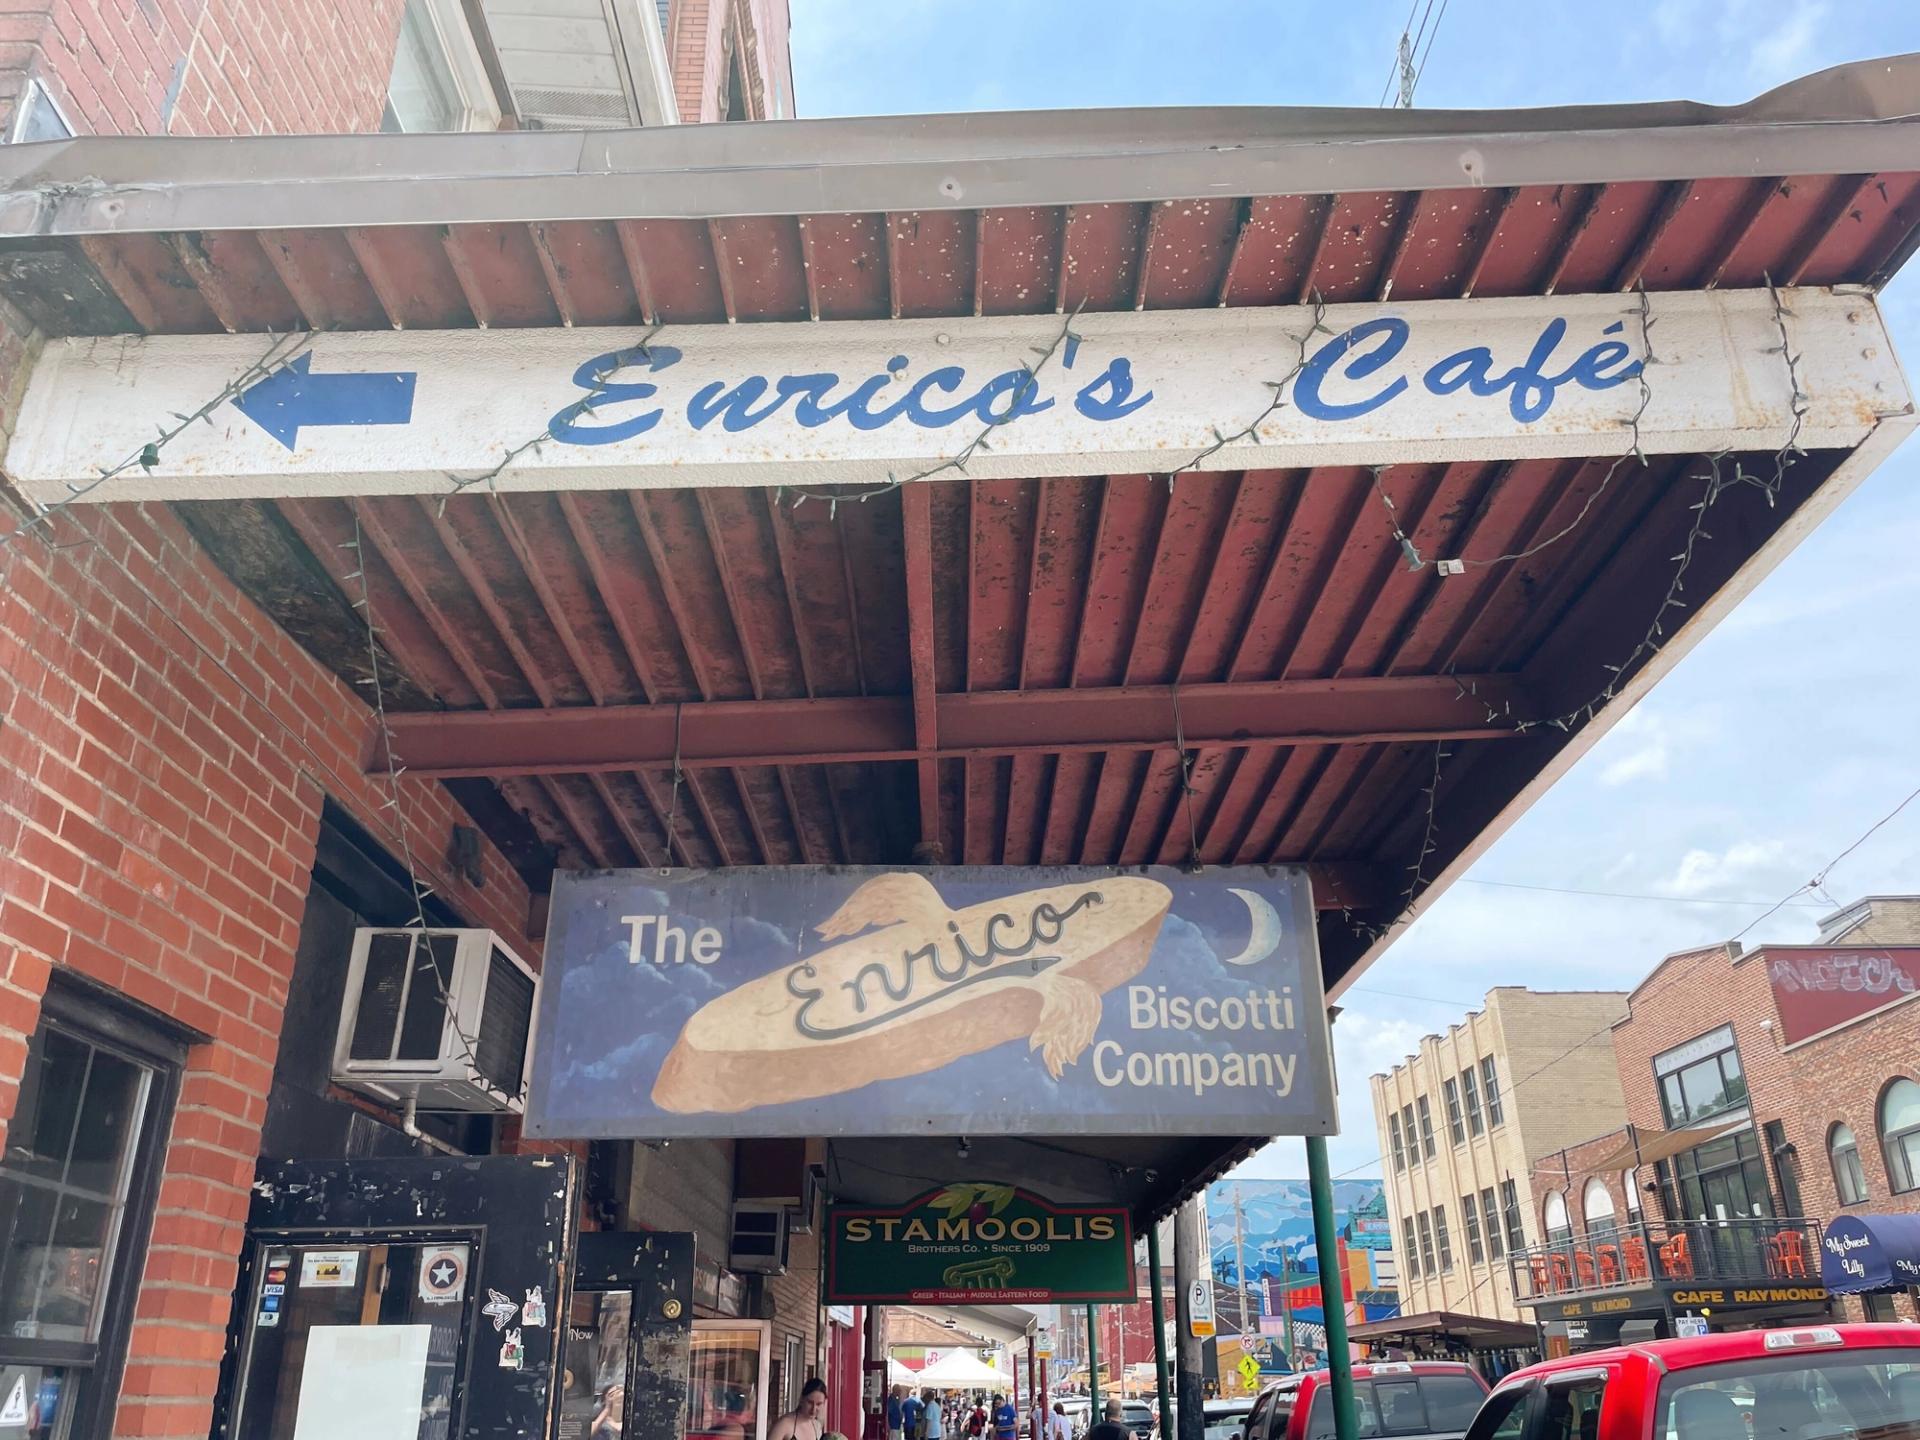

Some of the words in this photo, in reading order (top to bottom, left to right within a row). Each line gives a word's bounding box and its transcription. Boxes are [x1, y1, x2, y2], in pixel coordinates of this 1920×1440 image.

[549, 335, 1153, 445] Enrico's
[1293, 317, 1644, 424] Café
[620, 915, 723, 965] The
[786, 891, 1104, 1040] Enrico
[1129, 985, 1295, 1032] Biscotti
[1093, 1040, 1297, 1097] Company
[846, 1217, 1115, 1242] STAMOOLIS
[1025, 1243, 1051, 1252] 1909
[1826, 1236, 1845, 1257] My
[1844, 1233, 1870, 1250] Sweet
[1841, 1259, 1864, 1277] Lilly
[1562, 1303, 1582, 1317] CAFE
[1592, 1297, 1632, 1314] RAYMOND
[1672, 1290, 1725, 1304] CAFE
[1734, 1287, 1828, 1302] RAYMOND
